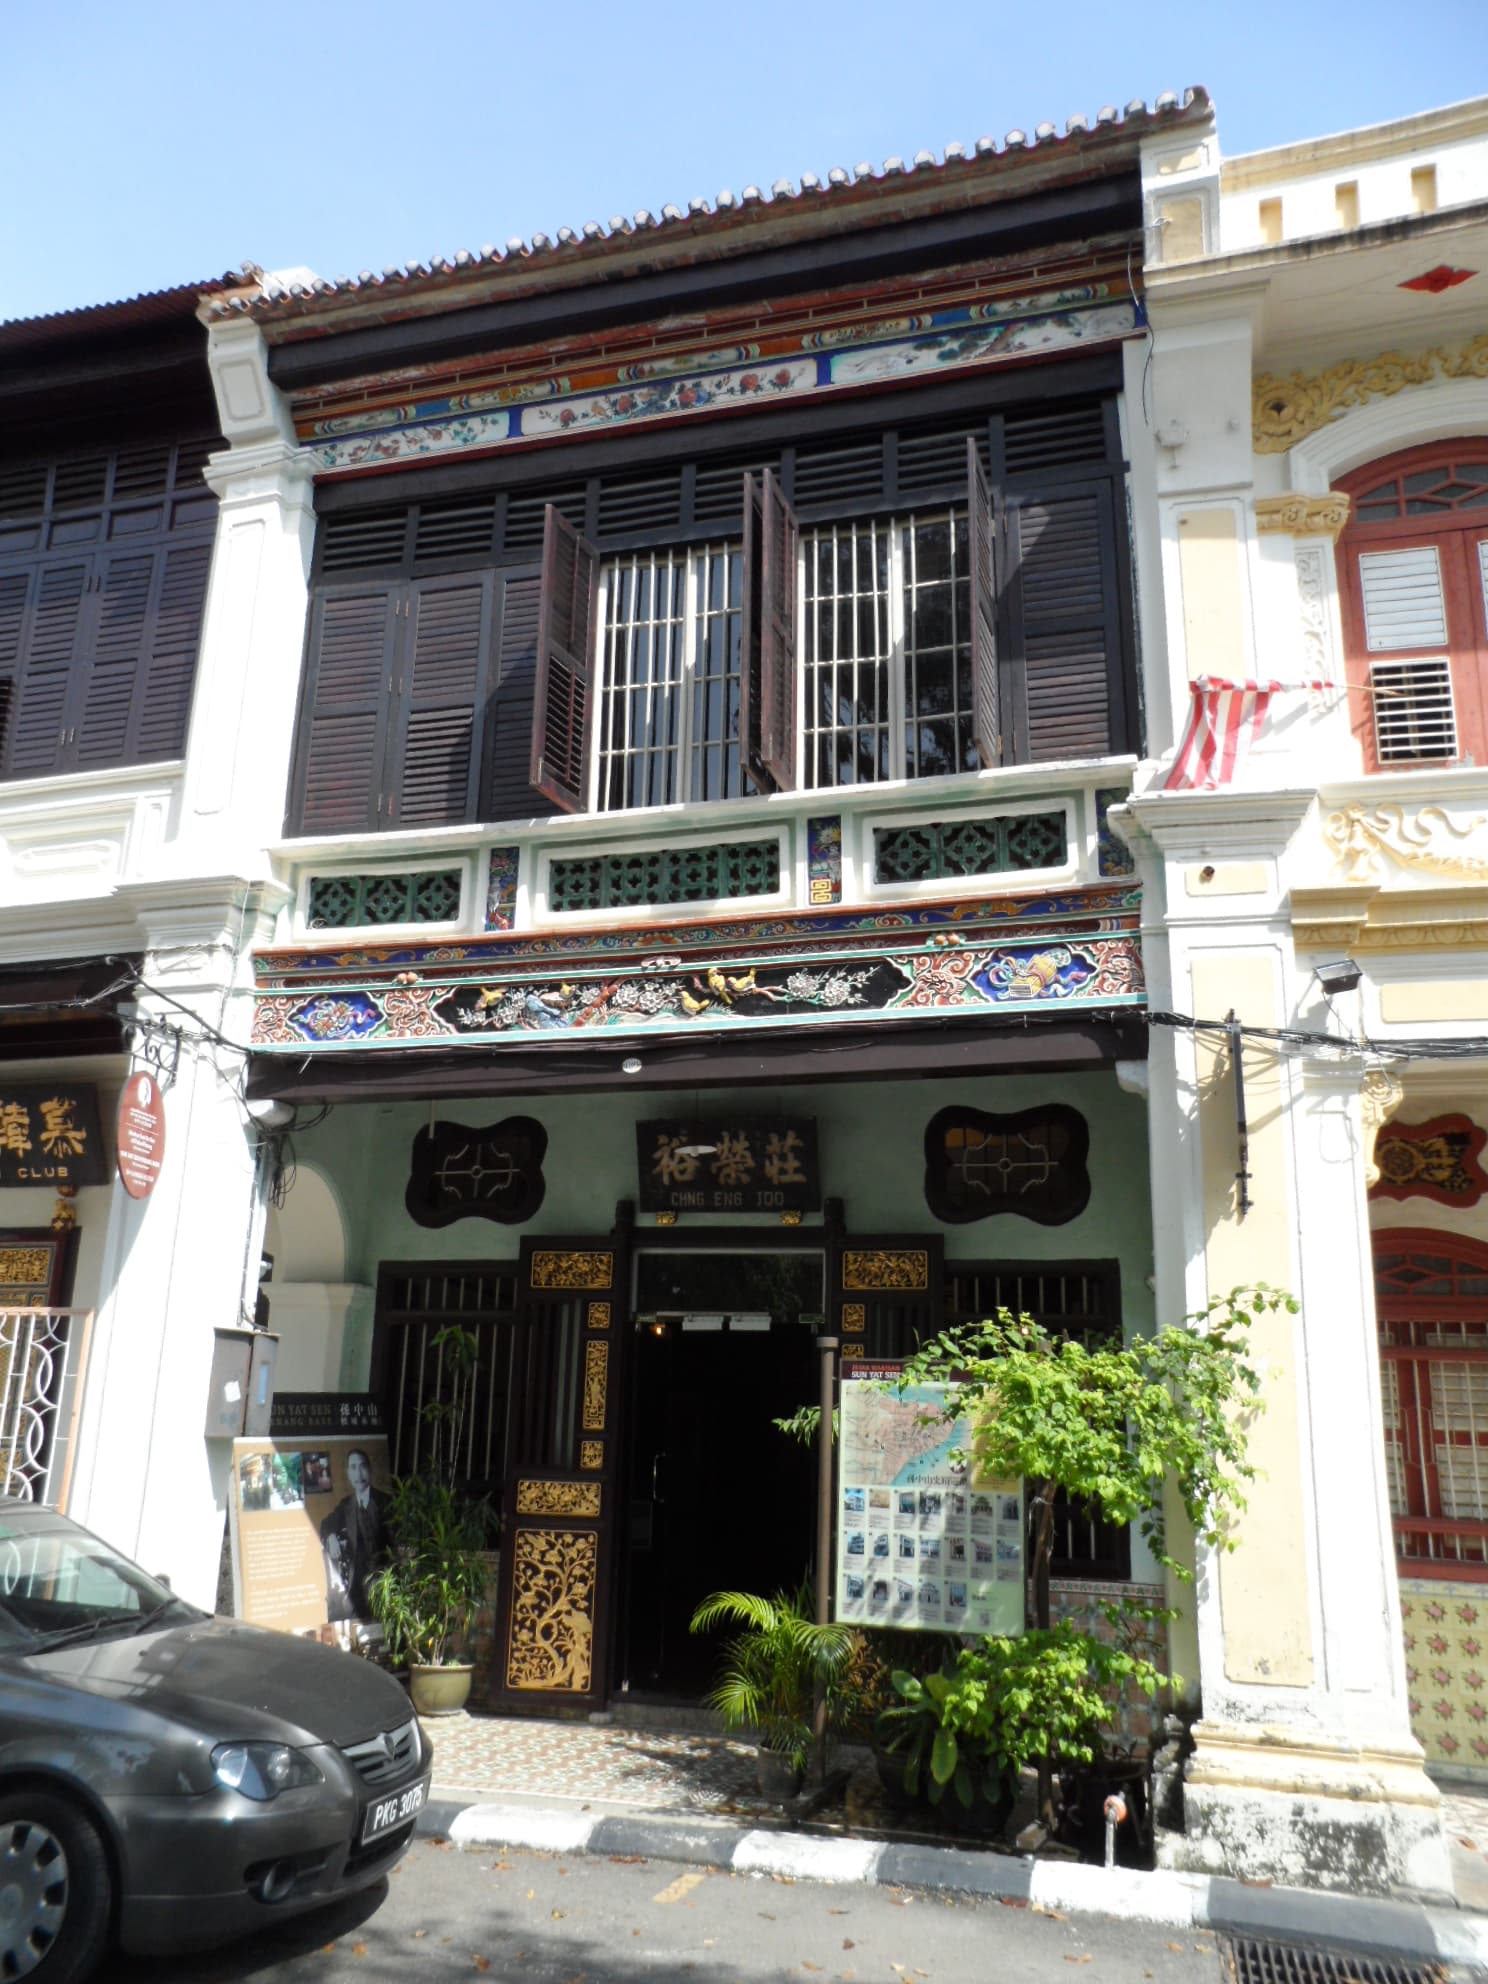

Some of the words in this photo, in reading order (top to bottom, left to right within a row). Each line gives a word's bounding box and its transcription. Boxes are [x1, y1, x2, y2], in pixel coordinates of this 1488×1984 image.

[17, 1167, 68, 1179] CLUB
[671, 1192, 705, 1206] CHNG
[714, 1192, 743, 1206] ENG
[287, 1404, 308, 1416] YAT
[311, 1404, 332, 1416] SEN
[373, 1798, 398, 1831] PKG
[399, 1783, 424, 1817] 3075
